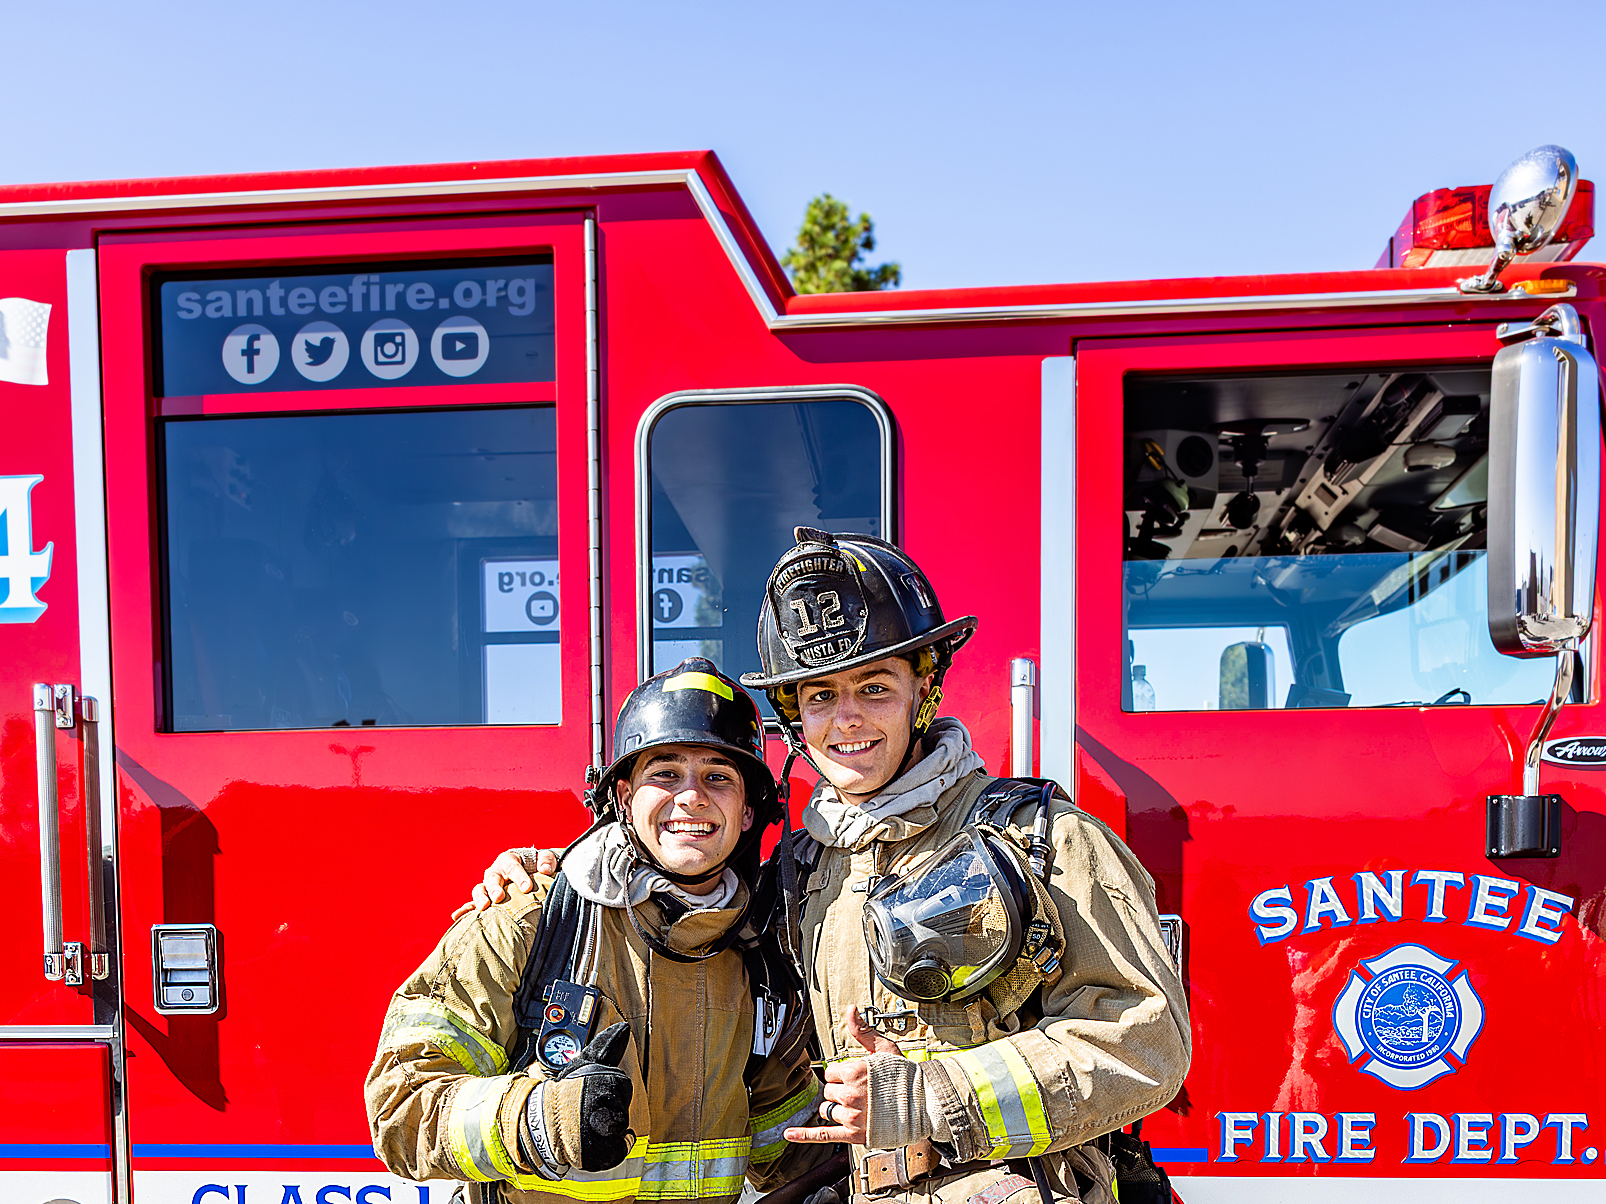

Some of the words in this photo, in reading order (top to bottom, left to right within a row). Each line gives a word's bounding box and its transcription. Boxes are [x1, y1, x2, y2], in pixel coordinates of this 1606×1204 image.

[176, 274, 537, 320] santeefire.org
[0, 474, 54, 624] 4
[777, 557, 845, 589] FIREFIGHTER
[789, 590, 845, 637] 12
[803, 641, 836, 660] VISTA
[837, 637, 852, 652] FD
[1249, 869, 1575, 948] SANTEE
[1362, 996, 1375, 1019] CITY
[1370, 983, 1382, 997] OF
[1381, 970, 1418, 987] SANTEE,
[1420, 973, 1455, 1018] CALIFORNIA
[1375, 1043, 1426, 1062] INCORPORATED
[1426, 1044, 1440, 1057] 1980
[529, 1091, 541, 1132] KNIGHT
[1214, 1111, 1377, 1165] FIRE
[1402, 1111, 1599, 1165] DEPT.
